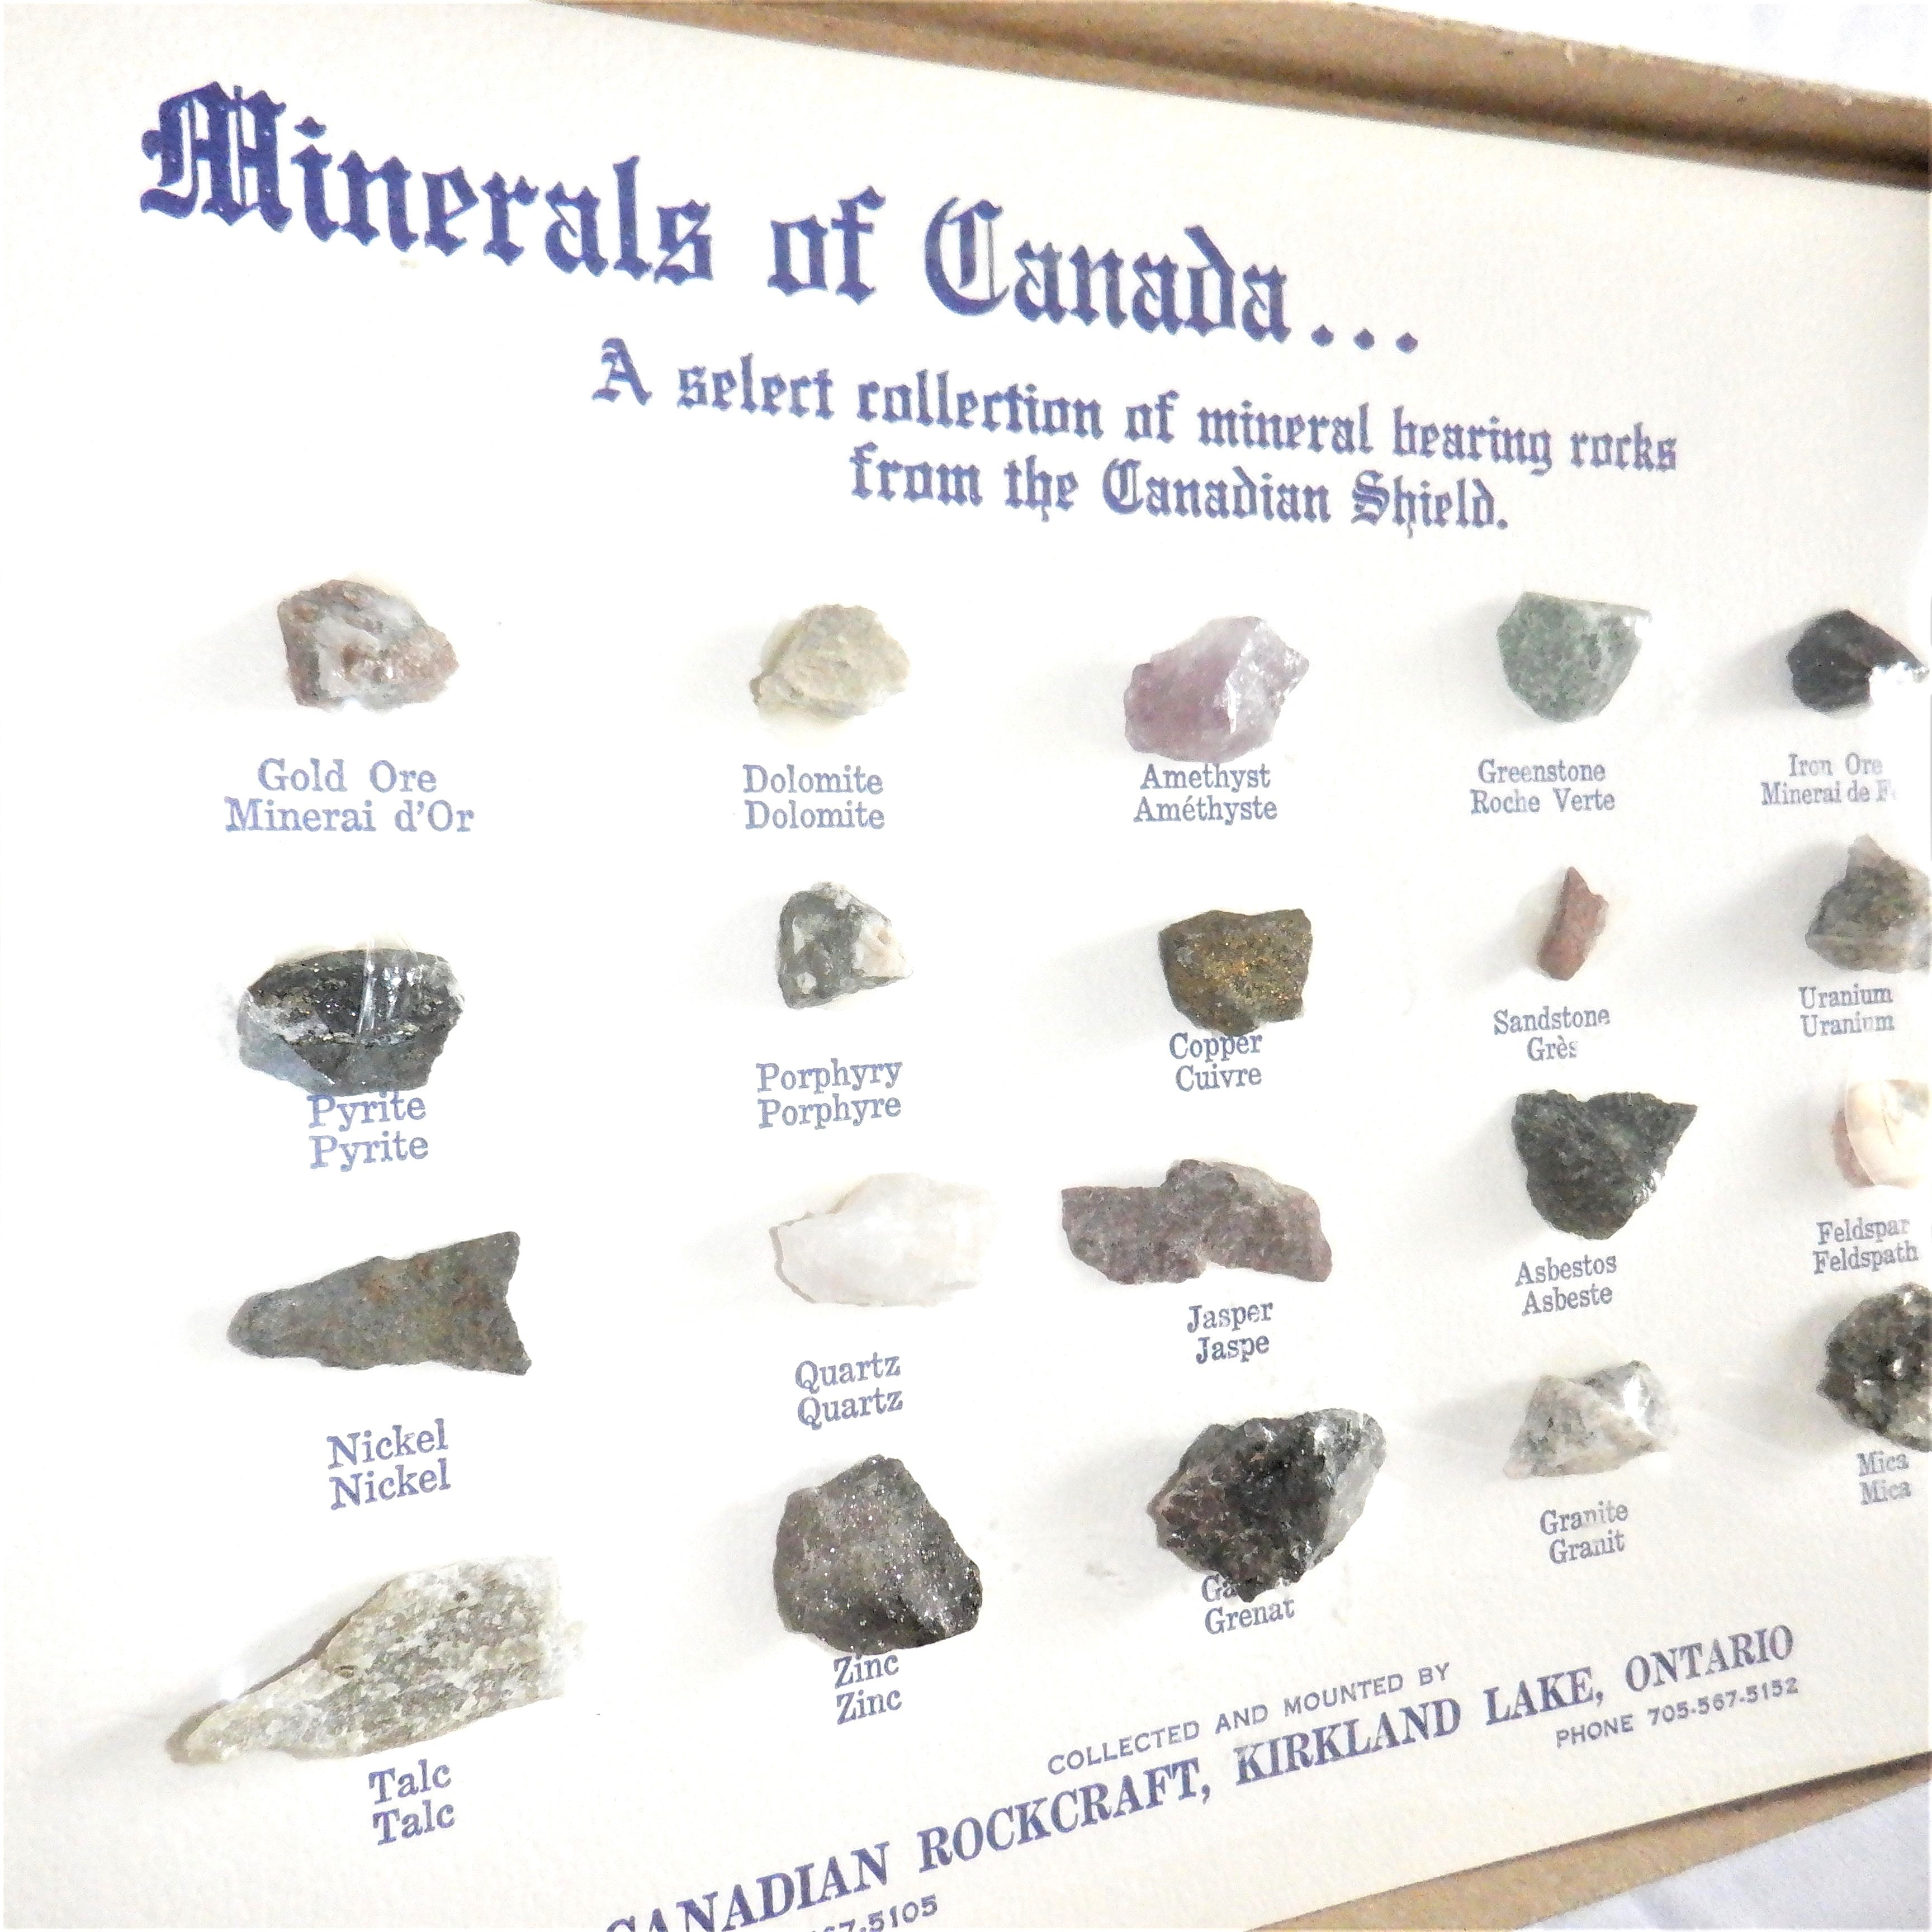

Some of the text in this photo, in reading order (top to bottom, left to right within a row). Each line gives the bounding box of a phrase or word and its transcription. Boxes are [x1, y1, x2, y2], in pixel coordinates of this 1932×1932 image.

[140, 81, 713, 286] Minerals
[768, 186, 886, 305] of
[591, 338, 1677, 476] A select collection of mineral bearing rocks
[849, 442, 1508, 539] from the Canadian Shield.
[258, 757, 437, 793] Gold Ore
[742, 764, 883, 795] Dolomite
[1140, 763, 1271, 793] Amethyst
[1478, 759, 1606, 784] Greenstone
[1788, 752, 1883, 777] Iron Ore
[1470, 787, 1615, 815] Roche Verte
[1760, 780, 1843, 806] Minerai
[1846, 779, 1871, 803] de
[224, 796, 474, 832] Minerai d'Or
[744, 799, 885, 830] Dolomite
[1133, 795, 1277, 826] Améthyste
[1798, 983, 1893, 1009] Uranium
[1493, 1005, 1611, 1035] Sandstone
[1169, 1032, 1262, 1063] Copper
[1527, 1035, 1576, 1061] Grès
[756, 1058, 903, 1095] Porphyry
[1176, 1063, 1262, 1092] Cuivre
[307, 1091, 426, 1132] Pyrite
[757, 1093, 901, 1130] Porphyre
[309, 1130, 428, 1172] Pyrite
[1816, 1216, 1910, 1246] Feldspar
[1515, 1254, 1617, 1287] Asbestos
[1812, 1240, 1919, 1275] Feldspath
[1522, 1283, 1613, 1316] Asbeste
[1187, 1303, 1273, 1333] Jasper
[1196, 1336, 1269, 1364] Jaspe
[795, 1352, 901, 1394] Quartz
[798, 1387, 903, 1431] Quartz
[326, 1418, 448, 1470] Nickel
[1857, 1451, 1909, 1477] Mica
[329, 1457, 451, 1510] Nickel
[1859, 1479, 1913, 1505] Mica
[1540, 1500, 1628, 1536] Granite
[1549, 1529, 1625, 1564] Granit
[1205, 1599, 1294, 1634] Grenat
[834, 1654, 899, 1689] Zinc
[836, 1689, 902, 1725] Zinc
[1048, 1661, 1450, 1775] COLLECTED AND MOUNTED BY
[1556, 1713, 1633, 1749] PHONE
[917, 1755, 1210, 1873] ROCKCRAFT,
[1233, 1692, 1461, 1786] KIRKLAND
[1483, 1666, 1603, 1726] LAKE,
[1625, 1625, 1794, 1693] ONTARIO
[368, 1759, 452, 1805] Talc
[372, 1800, 455, 1845] Talc
